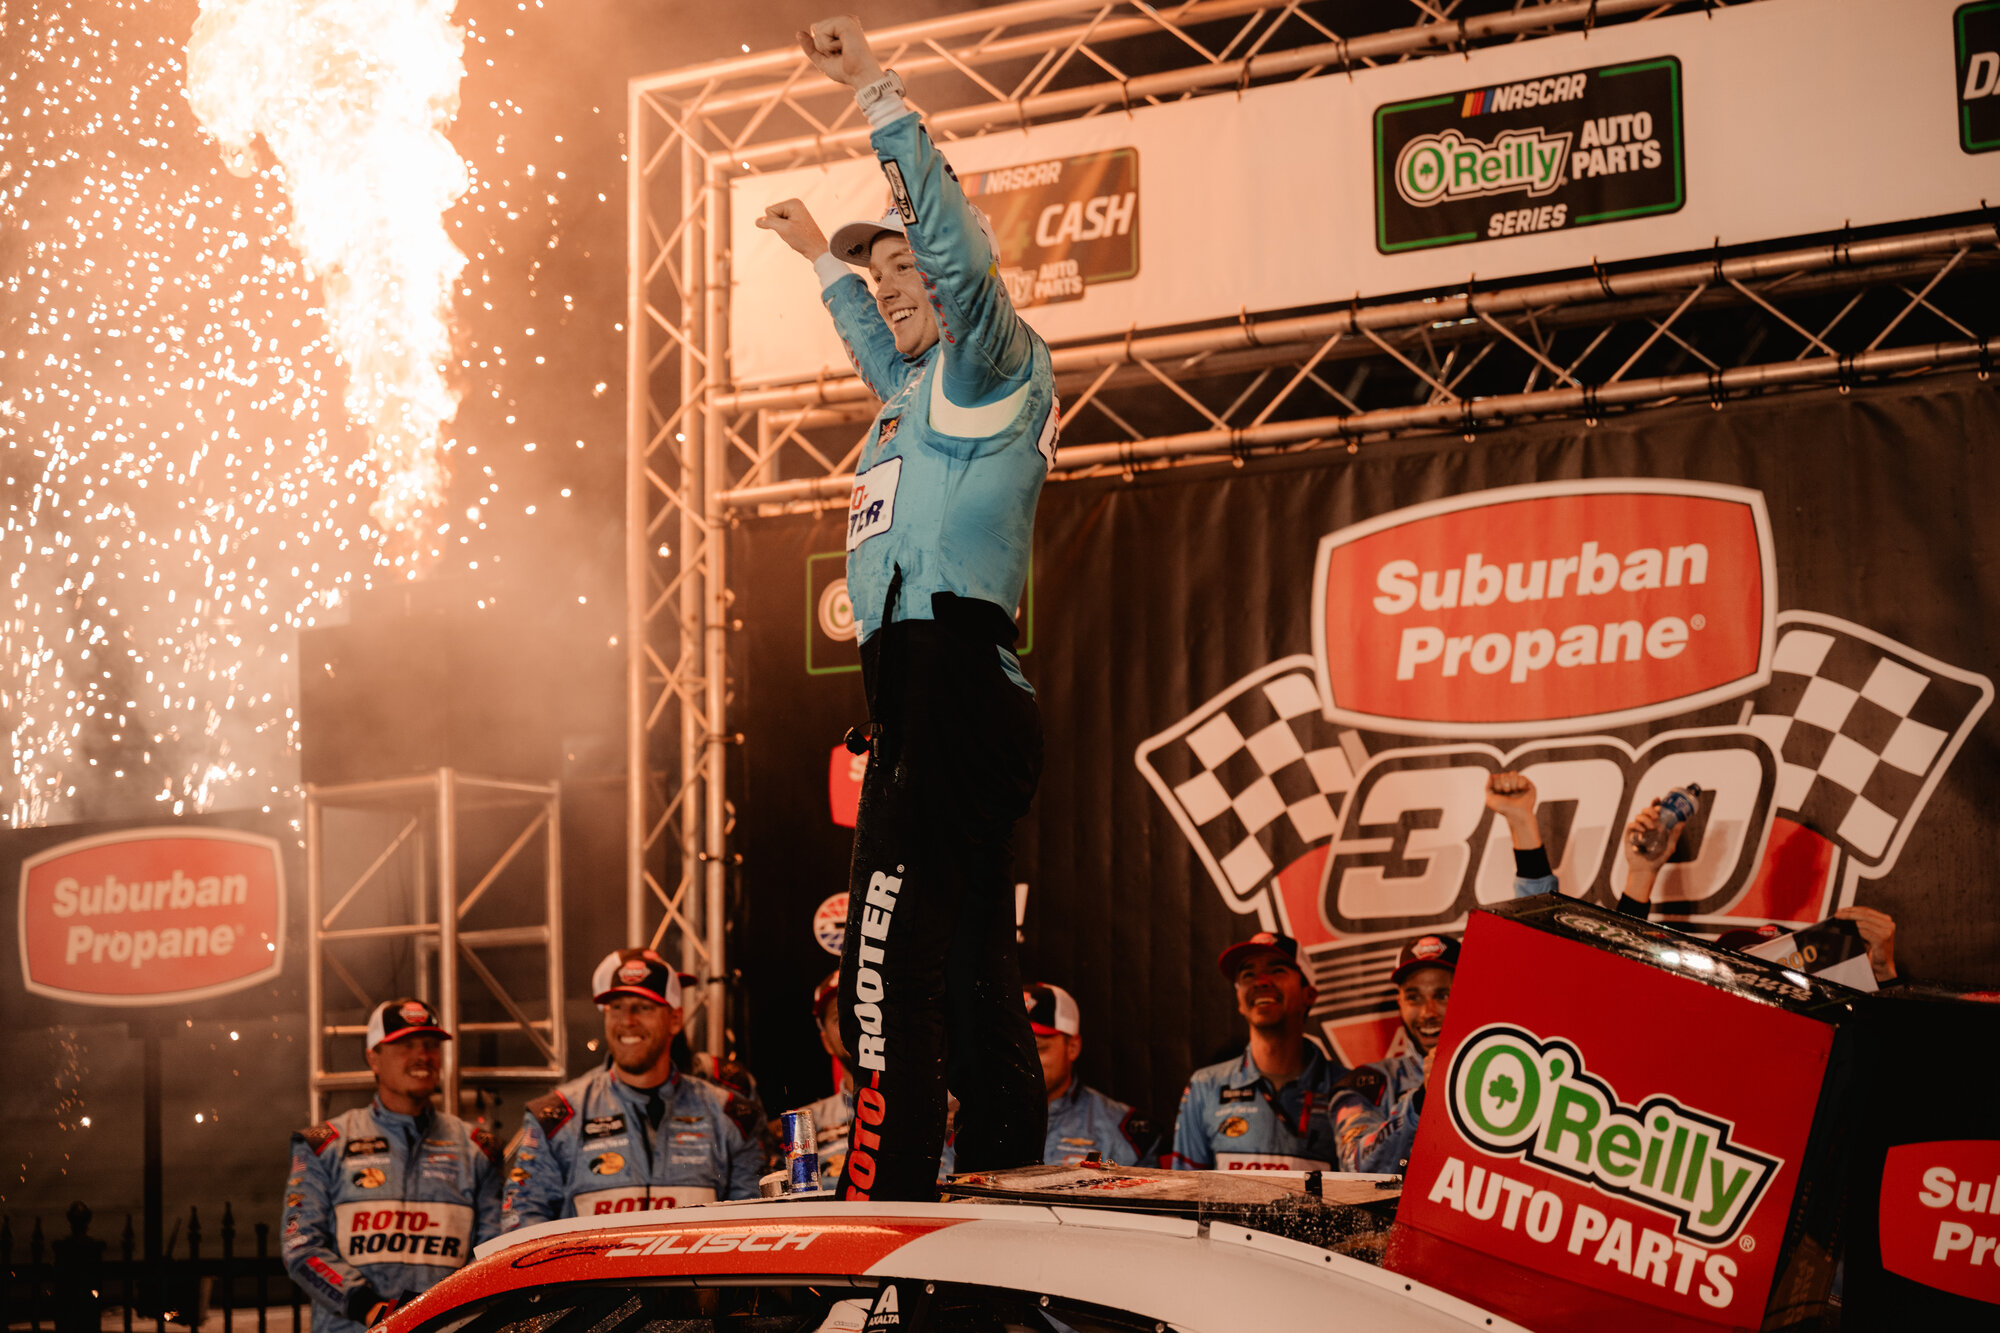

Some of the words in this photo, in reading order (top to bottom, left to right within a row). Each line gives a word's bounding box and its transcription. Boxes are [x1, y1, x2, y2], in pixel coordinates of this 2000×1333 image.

[1490, 73, 1587, 113] NASCAR
[1963, 51, 2000, 100] D
[1580, 111, 1652, 150] AUTO
[984, 161, 1062, 194] NASCAR
[1408, 141, 1557, 195] O'Reilly
[1572, 139, 1662, 180] PARTS
[1035, 192, 1136, 248] CASH
[1488, 204, 1567, 237] SERIES
[1034, 274, 1083, 299] PARTS
[1039, 258, 1079, 280] AUTO
[1374, 541, 1708, 615] Suburban
[1397, 615, 1690, 684] Propane
[1338, 748, 1764, 919] 300
[52, 869, 248, 918] Suburban
[66, 923, 236, 970] Propane
[1465, 1045, 1753, 1227] O'Reilly
[351, 1210, 439, 1233] ROTO-
[1428, 1156, 1563, 1244] AUTO
[1567, 1203, 1738, 1309] PARTS
[349, 1233, 461, 1259] ROOTER
[605, 1232, 822, 1257] ZILISCH
[1932, 1220, 2000, 1268] Pr
[868, 1314, 900, 1327] AXALTA
